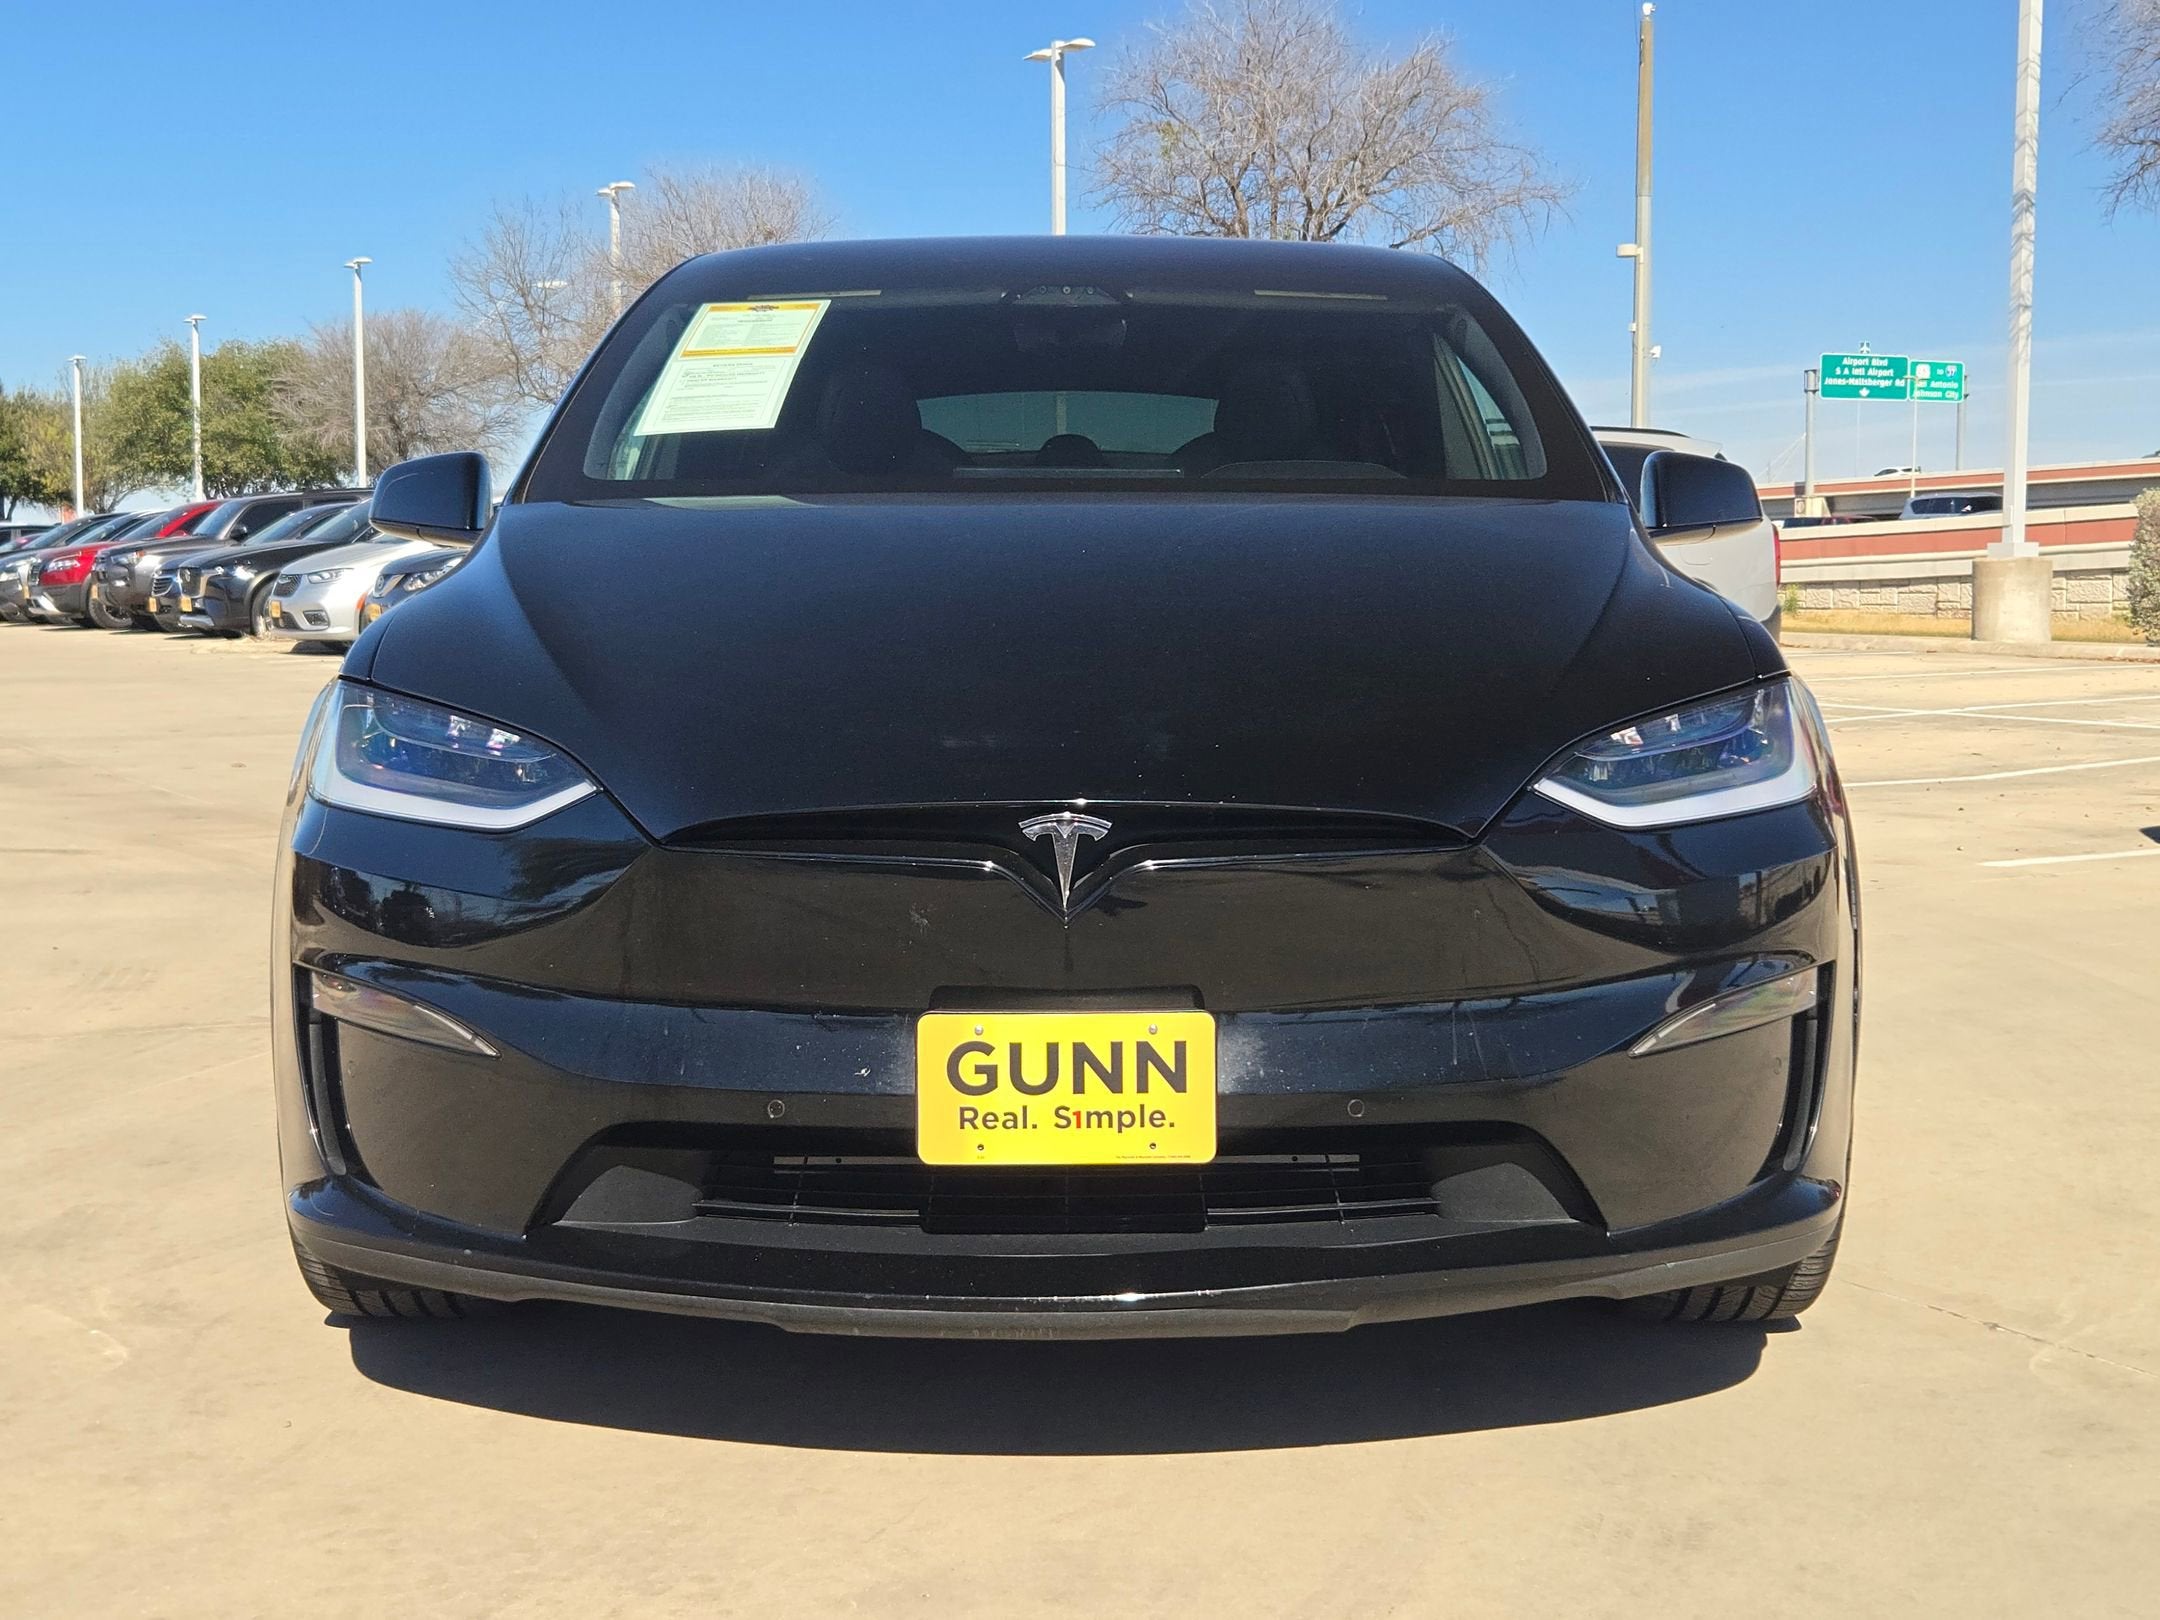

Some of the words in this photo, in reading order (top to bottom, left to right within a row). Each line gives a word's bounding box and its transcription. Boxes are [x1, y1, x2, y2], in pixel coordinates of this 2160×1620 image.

[1842, 357, 1869, 366] Airport
[1871, 358, 1888, 366] Blvd
[1835, 367, 1841, 375] S
[1843, 367, 1849, 375] A
[1867, 368, 1894, 377] Airport
[1894, 378, 1905, 387] Rd
[1930, 380, 1959, 389] Antonio
[946, 1040, 1187, 1097] GUNN
[959, 1104, 1038, 1130] Real.
